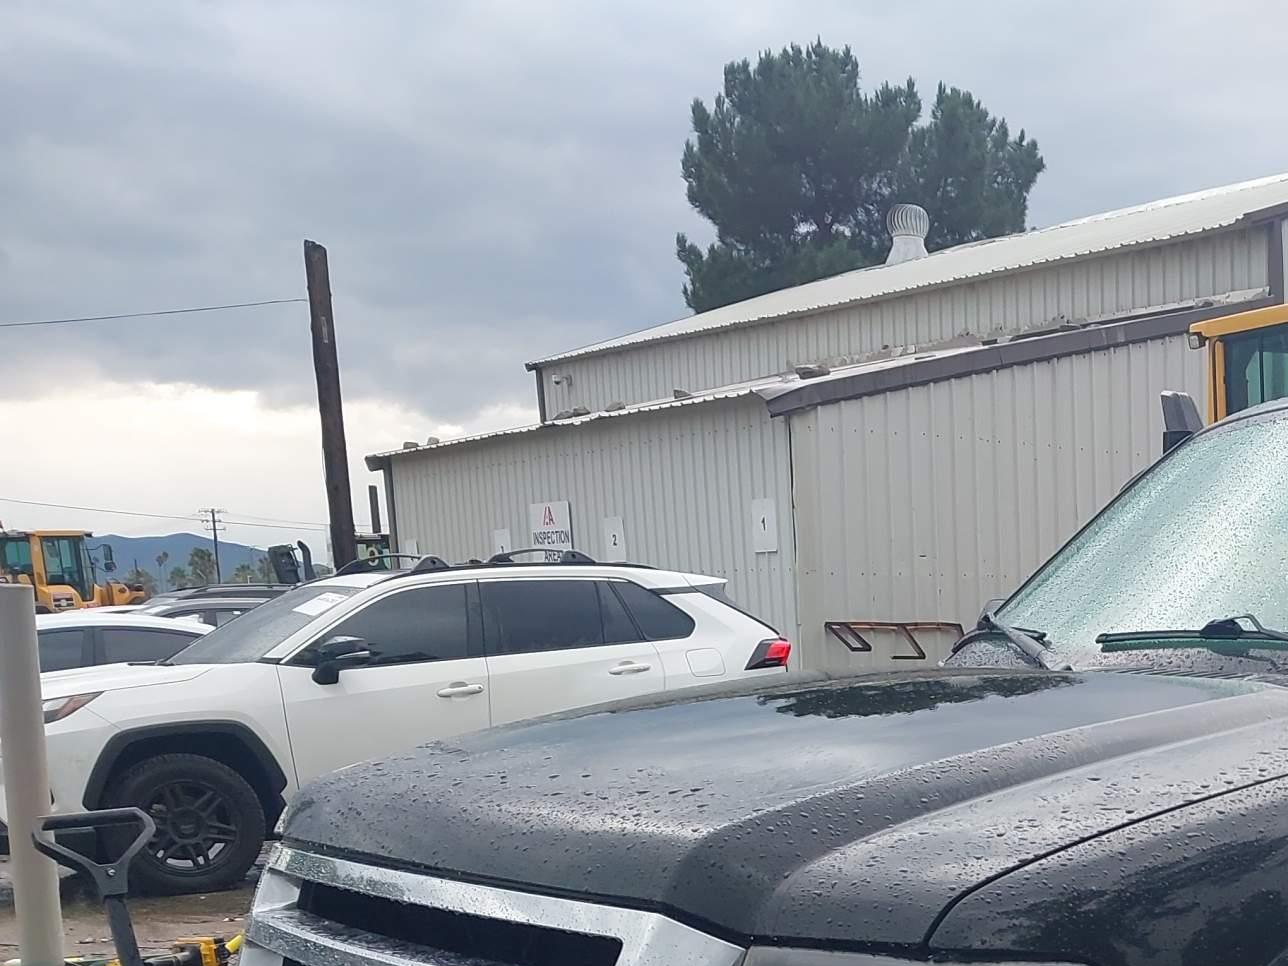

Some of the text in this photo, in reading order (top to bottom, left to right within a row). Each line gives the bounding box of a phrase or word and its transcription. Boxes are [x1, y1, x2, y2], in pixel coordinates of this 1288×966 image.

[761, 516, 766, 532] 1
[532, 530, 570, 546] INSPECTION
[612, 533, 618, 546] 2
